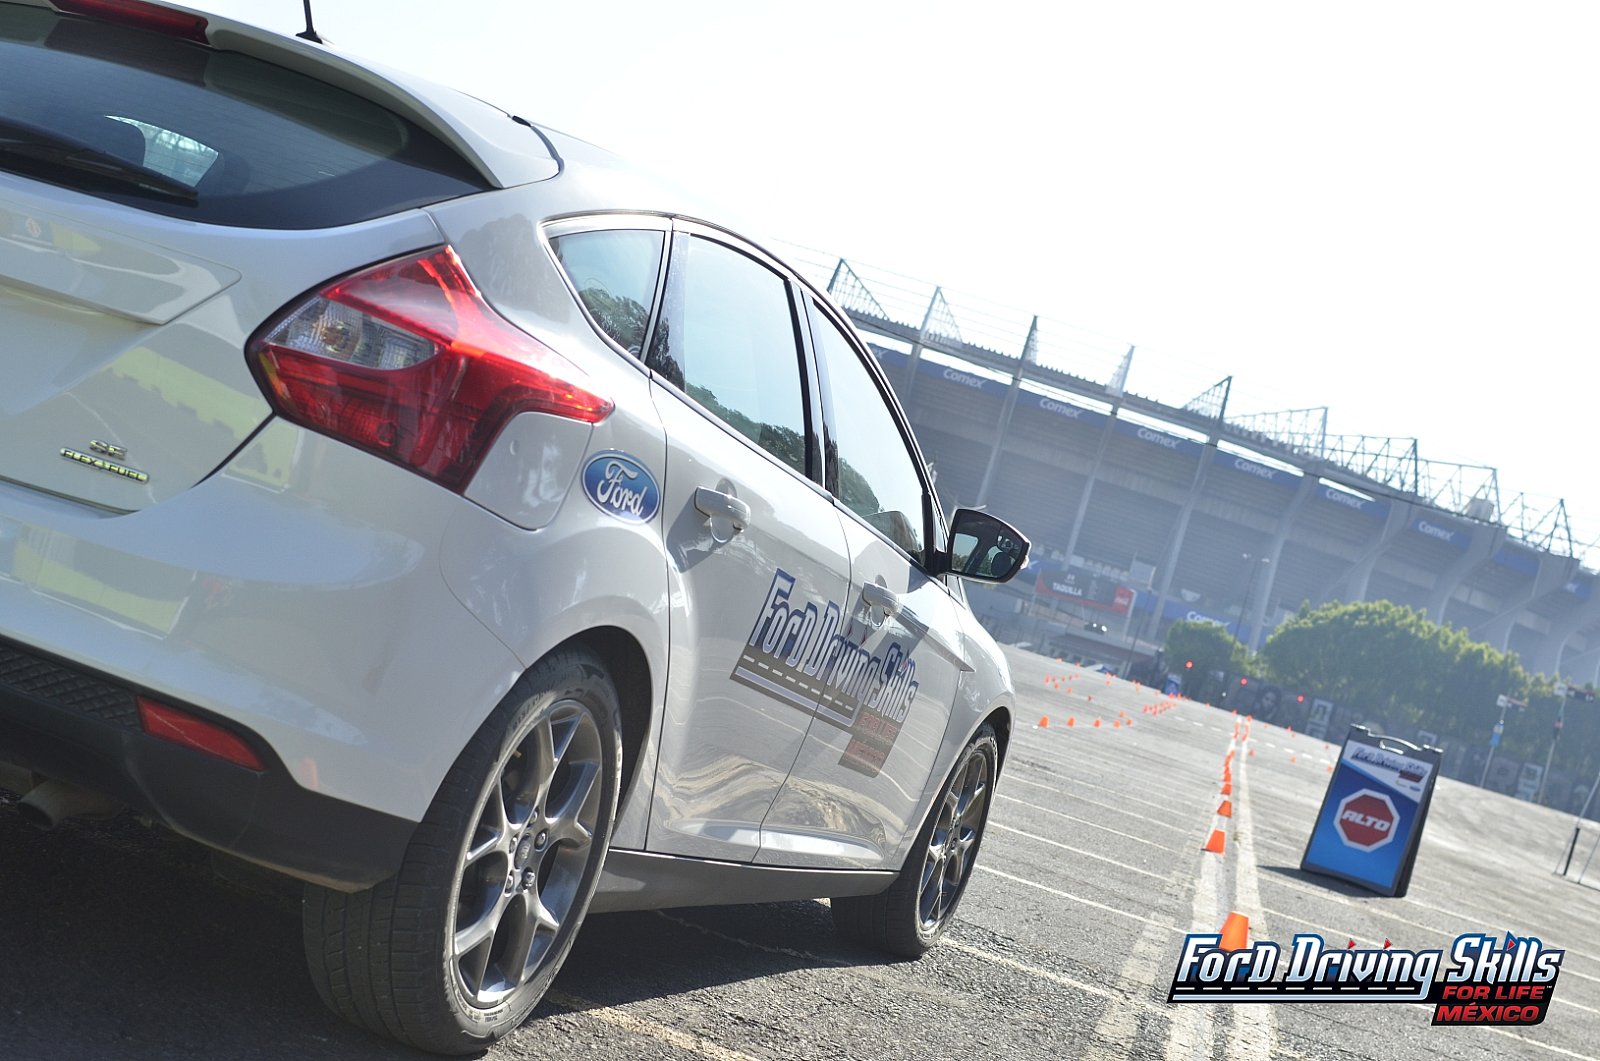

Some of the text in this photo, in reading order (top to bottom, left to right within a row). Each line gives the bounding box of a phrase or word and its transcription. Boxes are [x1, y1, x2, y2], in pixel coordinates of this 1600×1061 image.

[943, 368, 987, 389] Comex
[1039, 398, 1083, 419] Comex
[1137, 427, 1181, 449] Comex
[1234, 458, 1277, 480] Comex
[597, 461, 648, 516] Ford
[1325, 488, 1367, 510] Comex
[1342, 810, 1391, 832] ALTO
